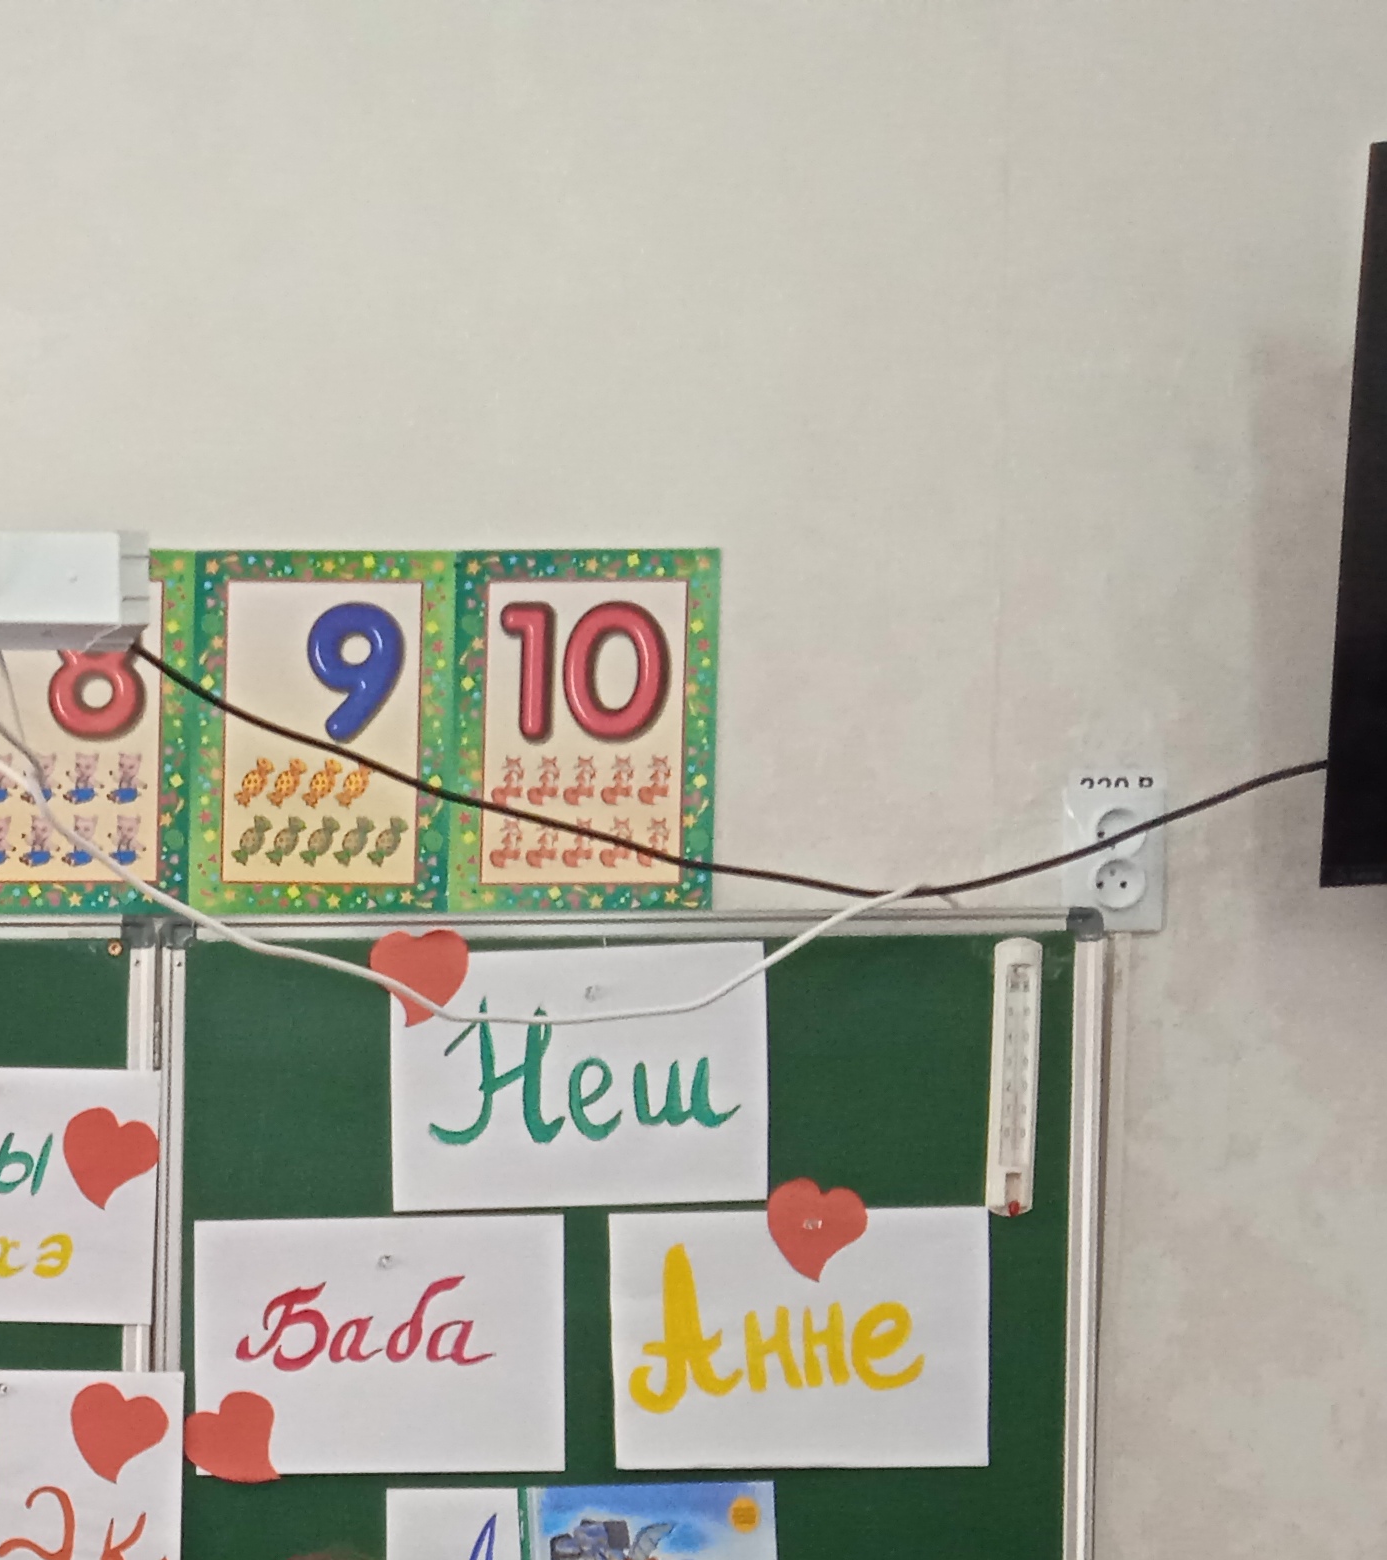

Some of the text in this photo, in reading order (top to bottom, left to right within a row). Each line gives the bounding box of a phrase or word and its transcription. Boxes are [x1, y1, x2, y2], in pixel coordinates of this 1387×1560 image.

[306, 601, 406, 742] 9
[500, 600, 672, 742] 10
[428, 999, 741, 1146] Неш
[235, 1276, 495, 1371] Баба
[629, 1243, 926, 1414] Анне
